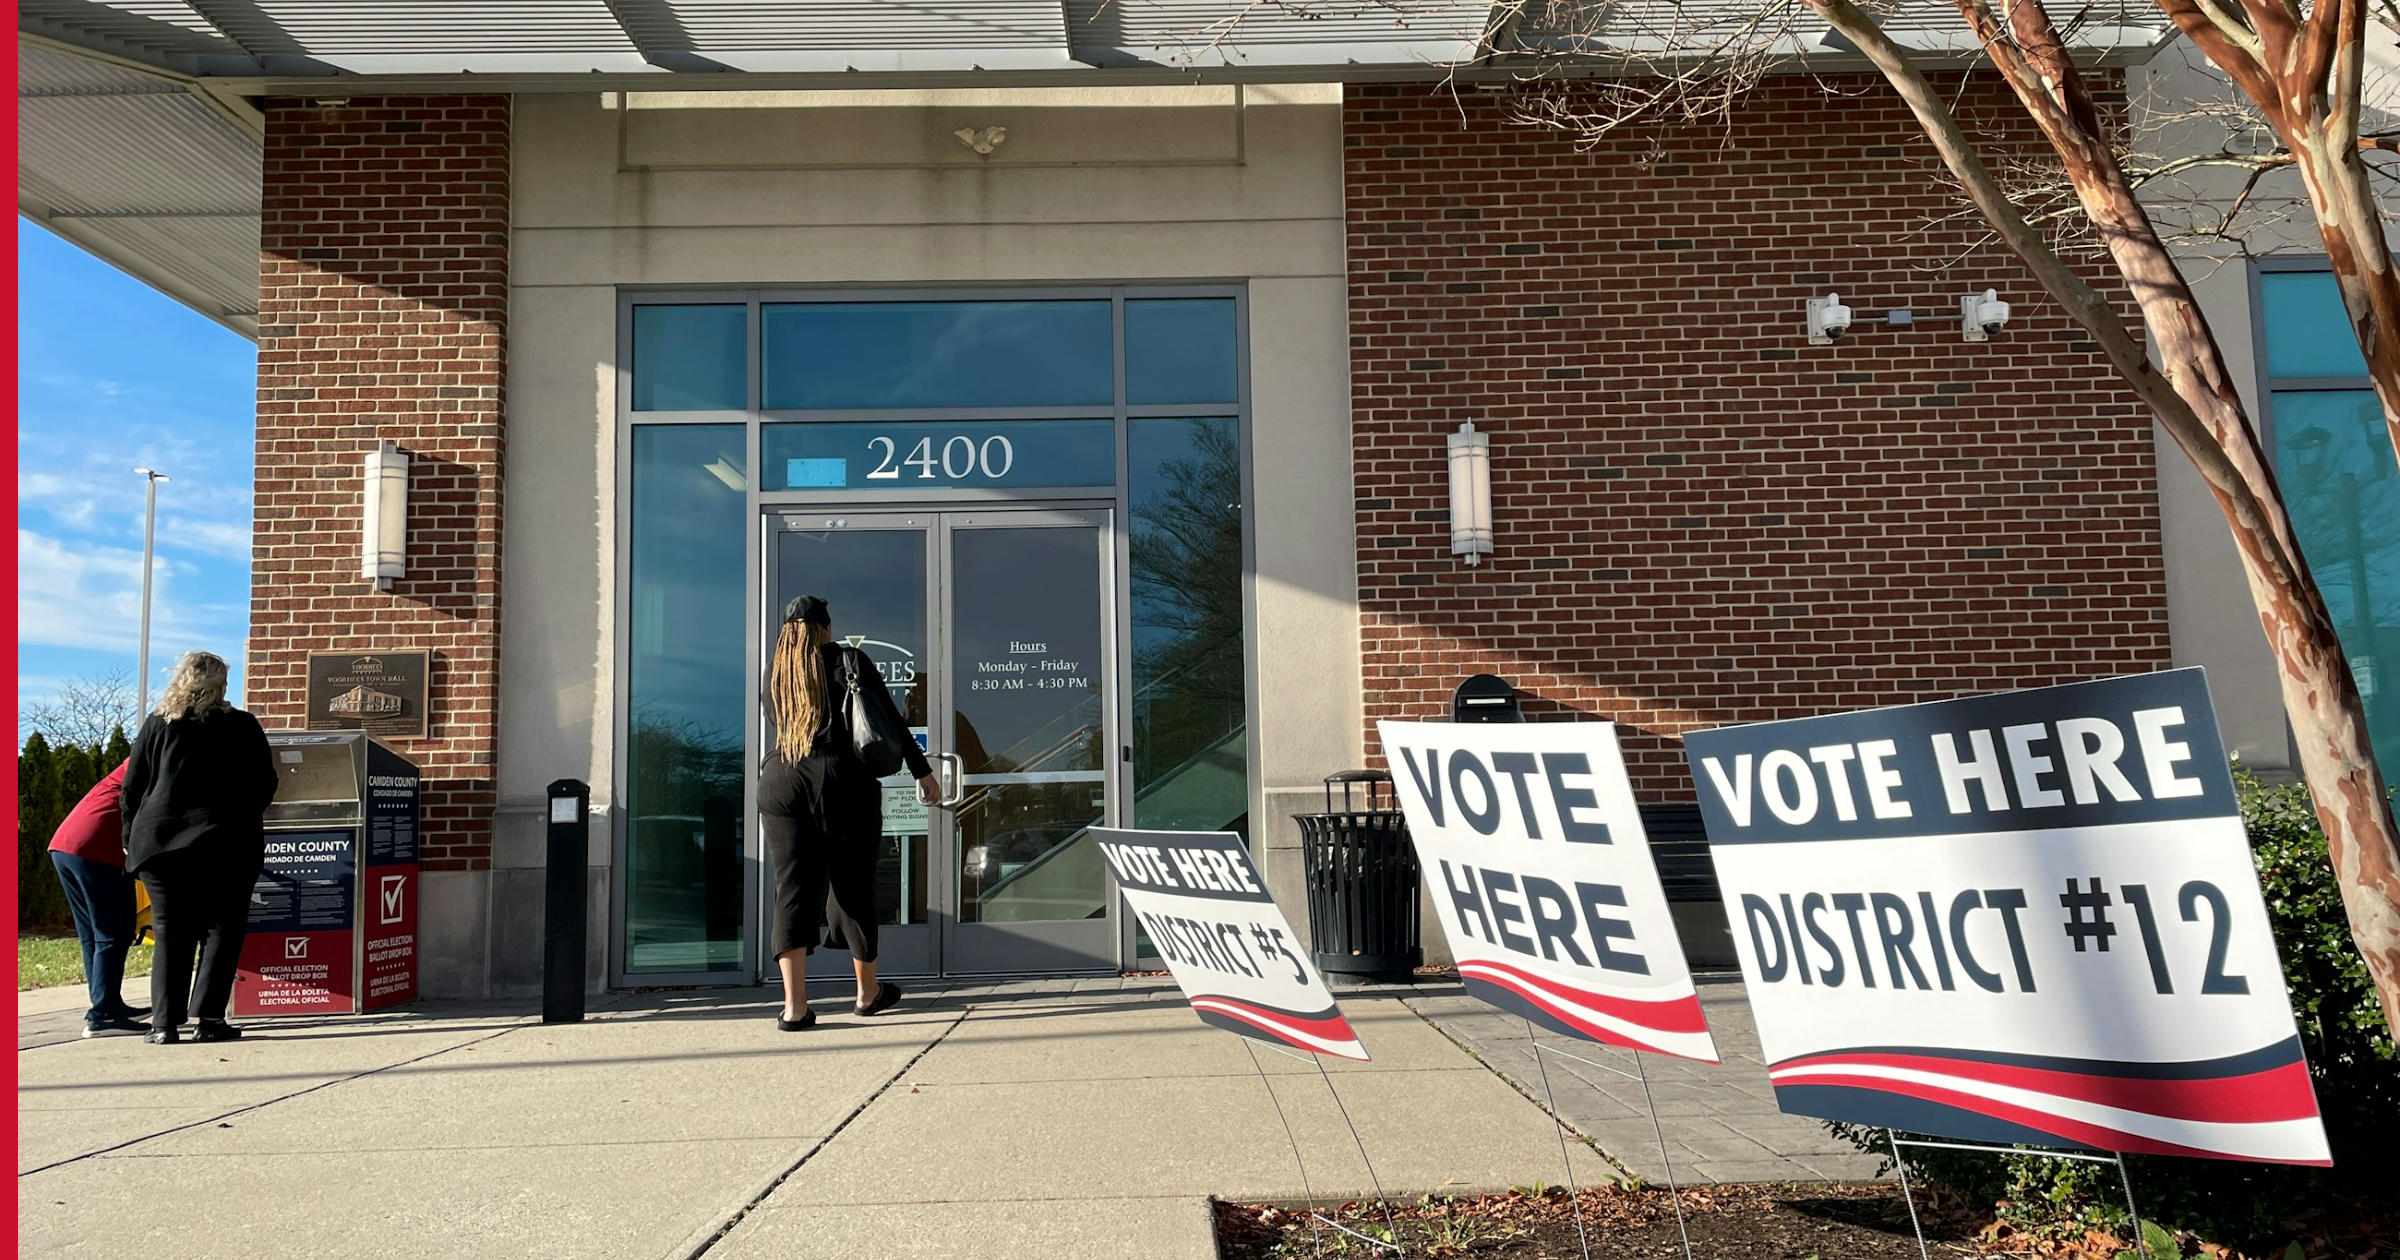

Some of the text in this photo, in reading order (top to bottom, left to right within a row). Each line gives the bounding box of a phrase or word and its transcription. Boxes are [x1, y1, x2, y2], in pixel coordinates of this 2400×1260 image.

[866, 435, 1013, 479] 2400
[1009, 641, 1047, 653] Hours
[978, 661, 1027, 674] Monday
[1041, 660, 1078, 673] Friday
[971, 680, 999, 690] 8:30
[1002, 679, 1023, 690] AM
[1037, 678, 1064, 689] 4:30
[1068, 677, 1087, 688] PM
[1702, 706, 2203, 827] VOTE HERE
[368, 776, 418, 787] CAMDEN COUNTY
[1400, 746, 1612, 845] VOTE
[264, 840, 350, 853] MDEN COUNTY
[305, 854, 336, 862] CAMDEN
[1099, 842, 1261, 893] VOTE HERE
[1440, 860, 1651, 975] HERE
[368, 935, 413, 950] OFFICIAL ELECTION
[1742, 877, 2251, 995] DISTRICT #12
[369, 947, 412, 963] BALLOT DROP BOX
[1142, 911, 1309, 986] DISTRICT #5
[293, 964, 328, 972] ELECTION
[302, 988, 330, 996] BOLETA
[260, 996, 330, 1005] ELECTORAL OFICIAL
